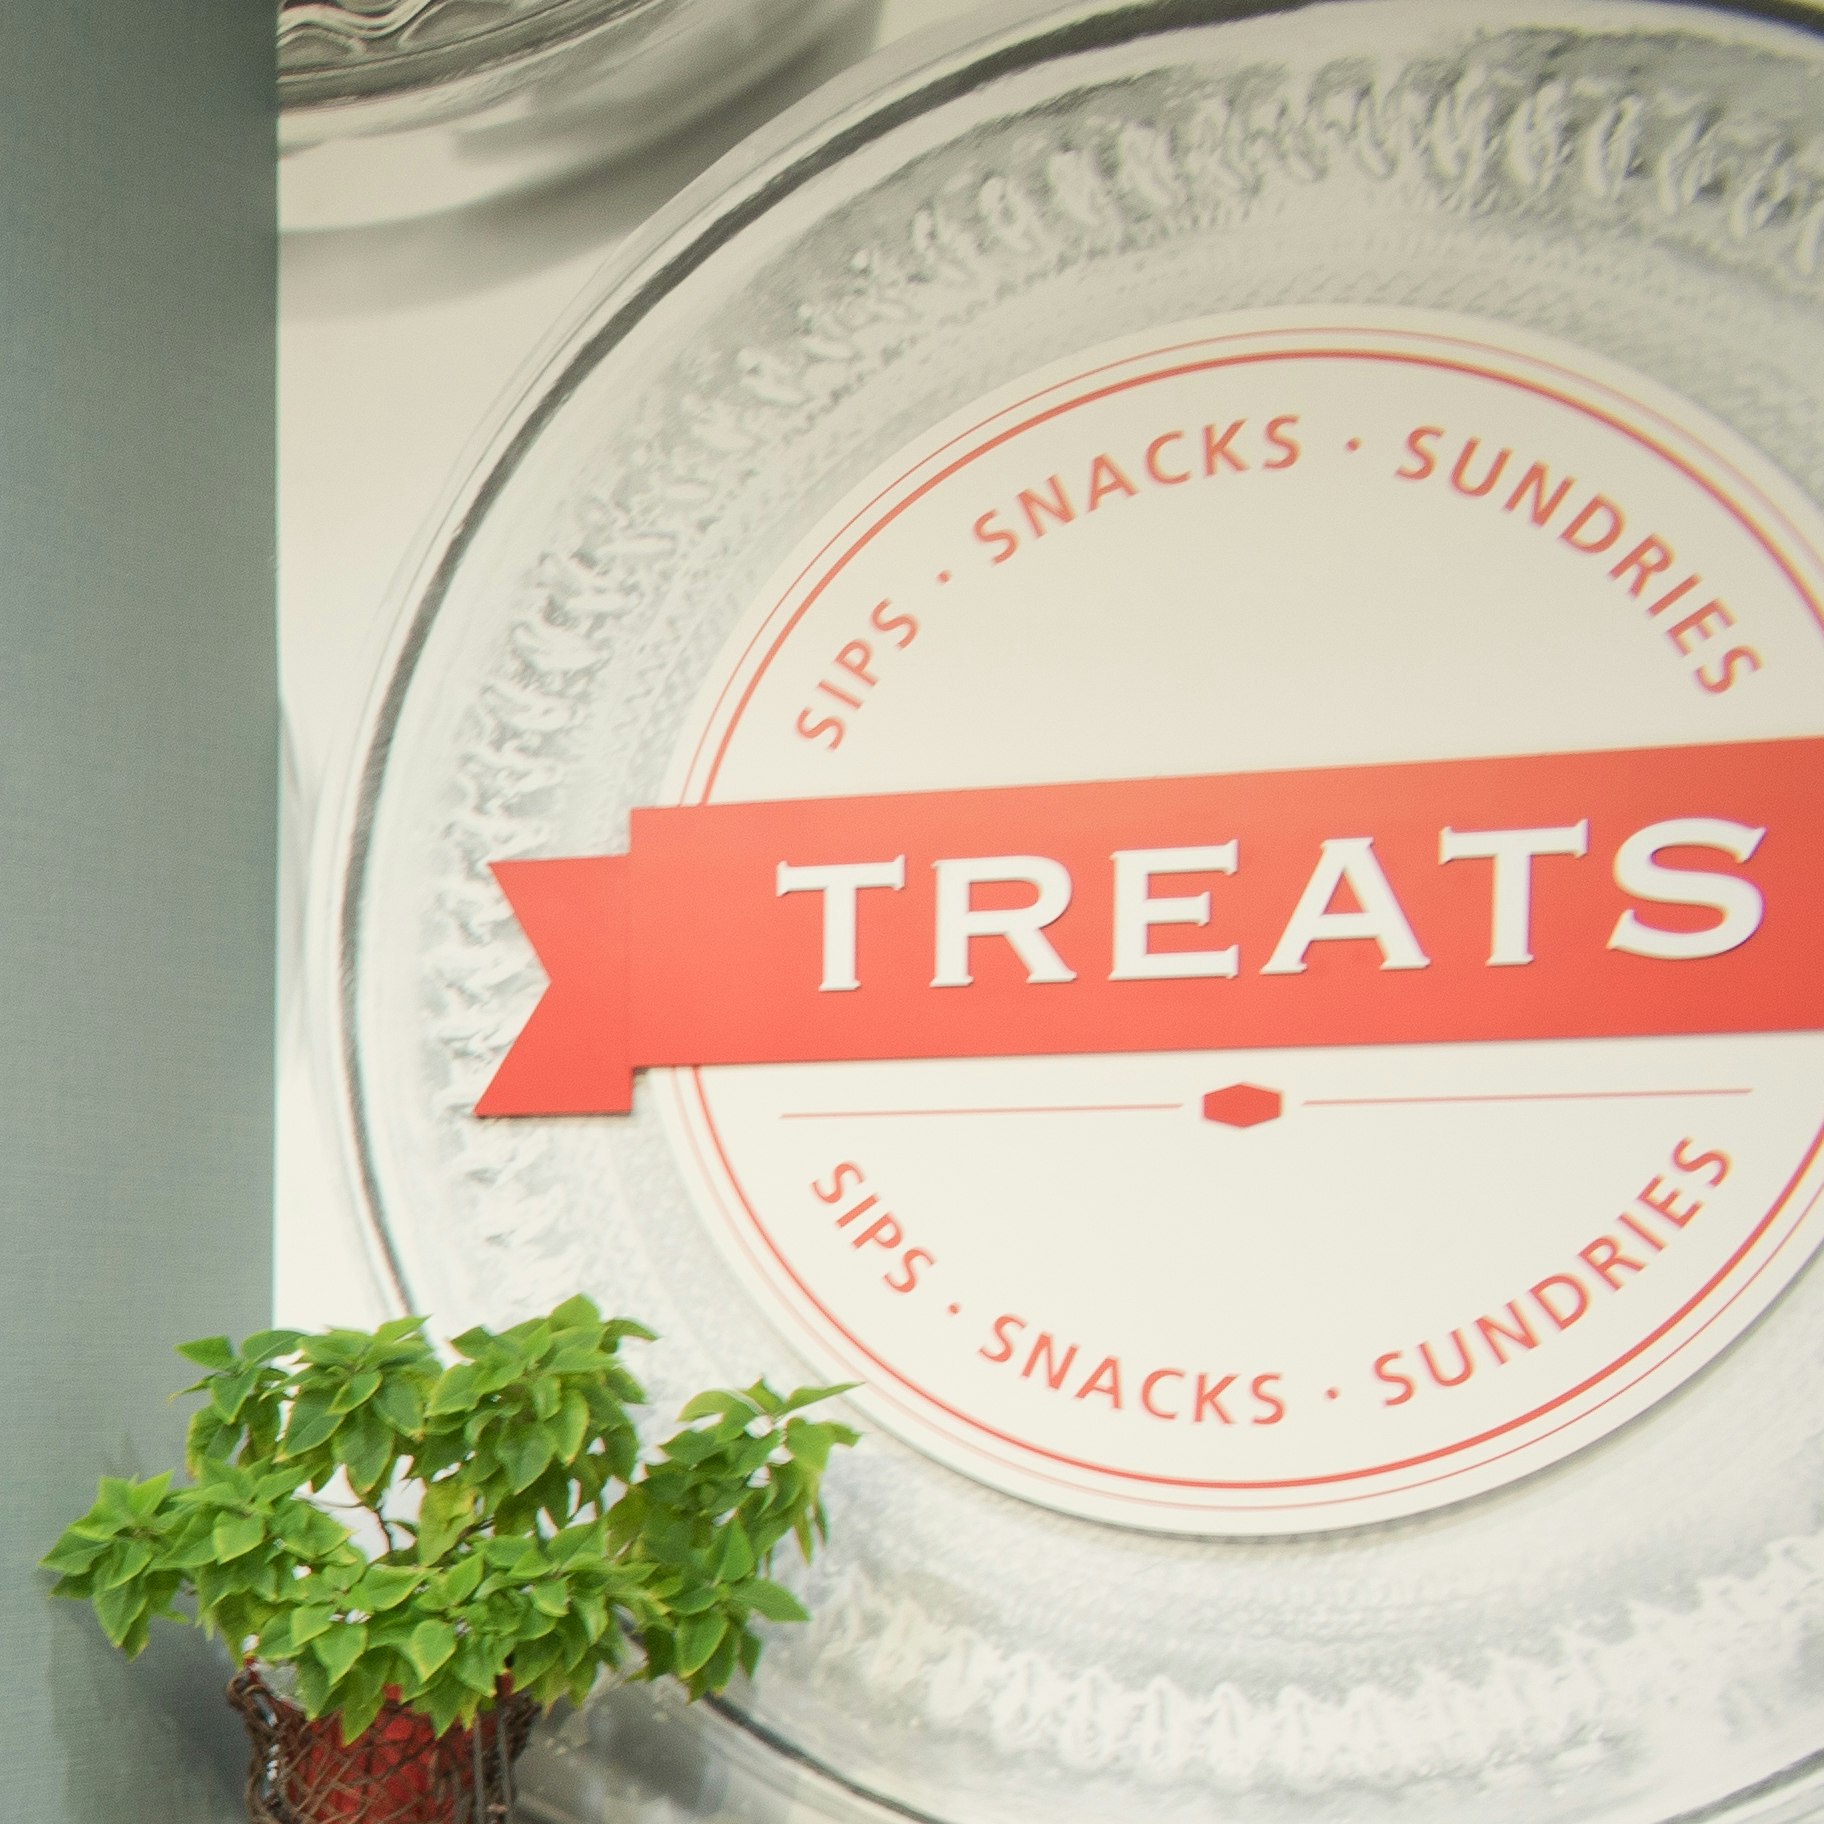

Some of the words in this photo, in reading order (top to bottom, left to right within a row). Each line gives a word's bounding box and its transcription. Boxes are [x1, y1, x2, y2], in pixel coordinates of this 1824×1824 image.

[793, 598, 921, 750] SIPS
[968, 413, 1304, 567] SNACKS
[1393, 423, 1762, 699] SUNDRIES
[775, 816, 1768, 993] TREATS
[810, 1159, 938, 1298] SIPS
[978, 1310, 1289, 1429] SNACKS
[1369, 1134, 1736, 1409] SUNDRIES
